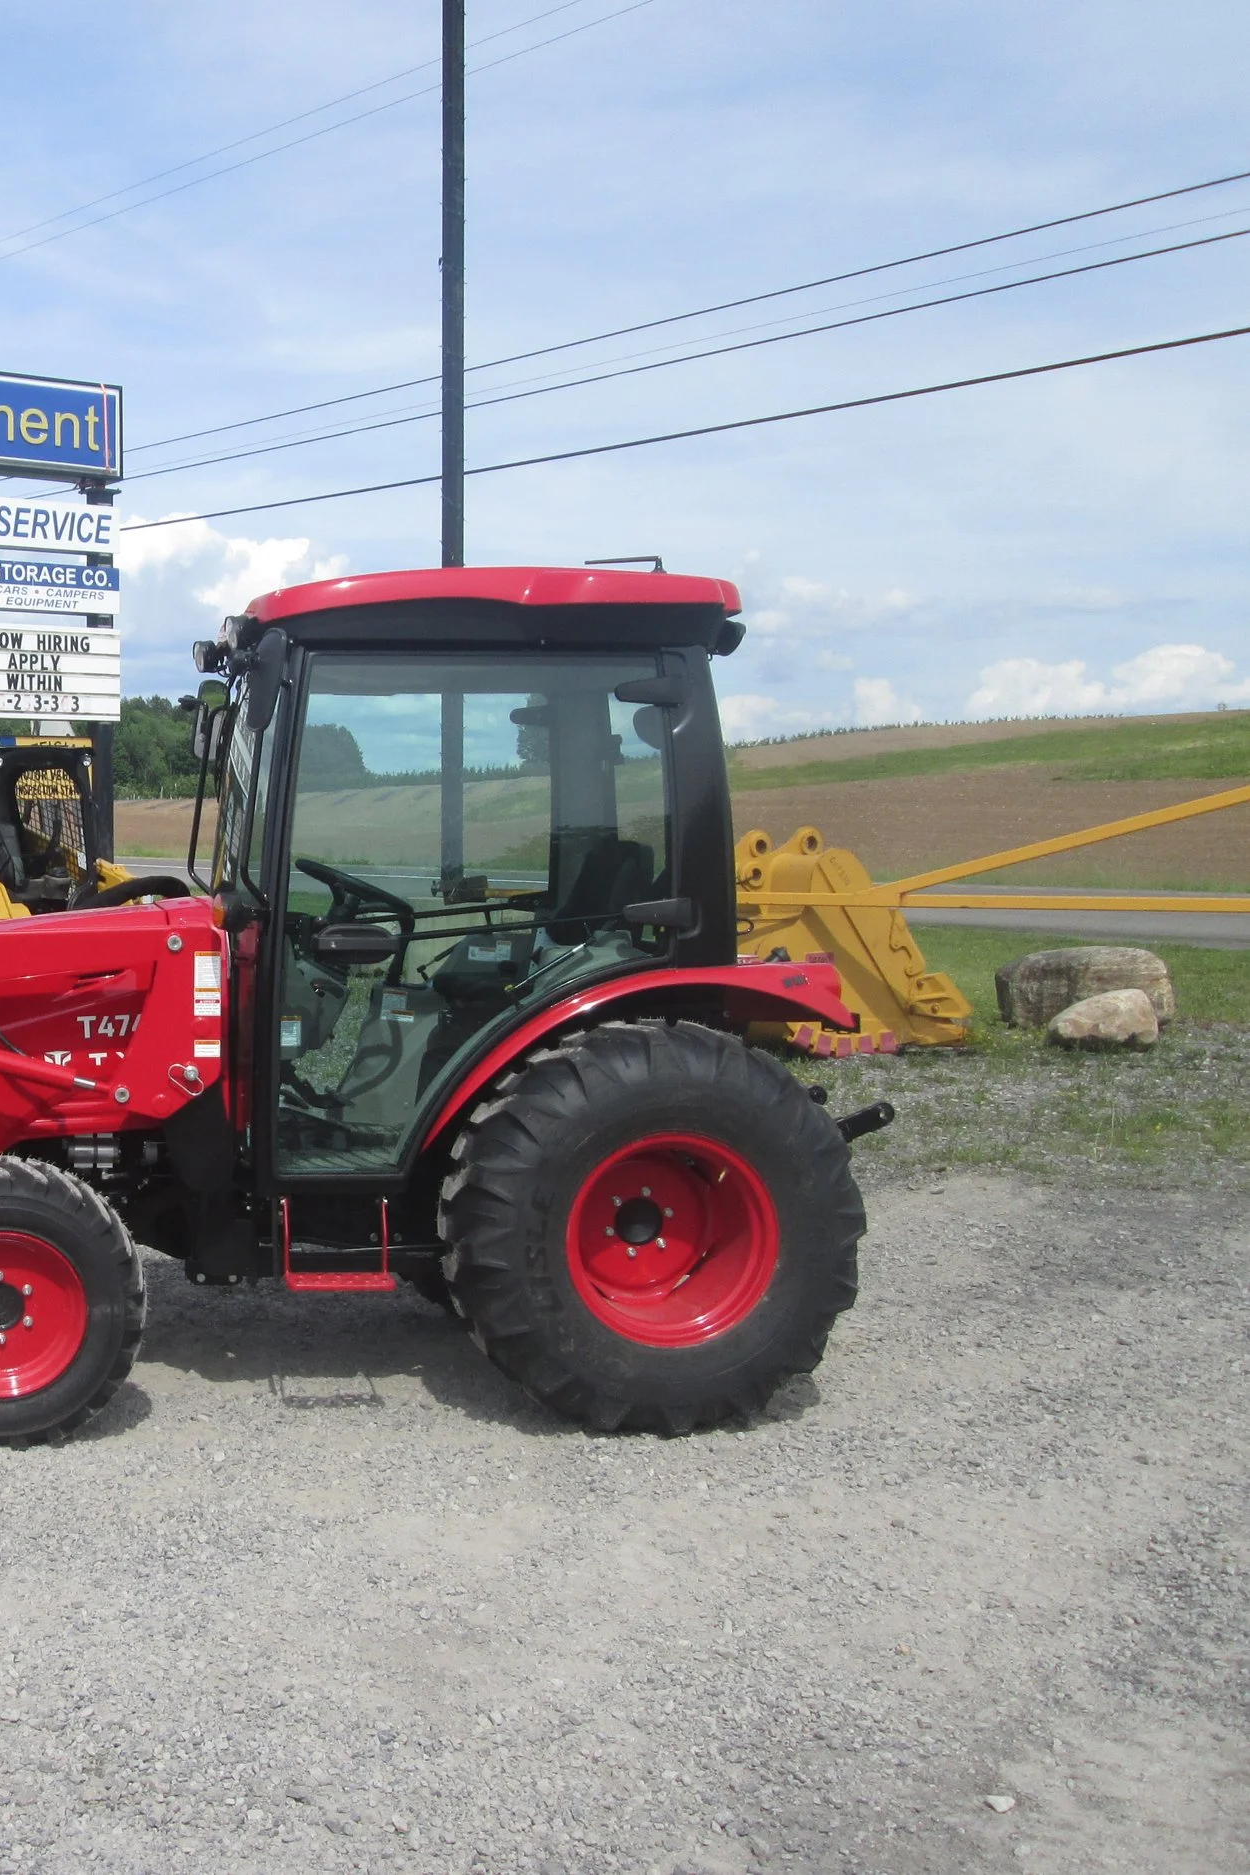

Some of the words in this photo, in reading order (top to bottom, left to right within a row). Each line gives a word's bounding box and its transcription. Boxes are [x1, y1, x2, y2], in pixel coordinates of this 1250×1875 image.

[81, 569, 112, 588] CO.
[5, 596, 80, 610] EQUIPMENT
[45, 588, 106, 601] CAMPERS
[36, 633, 91, 653] HIRING
[7, 652, 61, 672] APPLY
[6, 672, 63, 692] WITHIN
